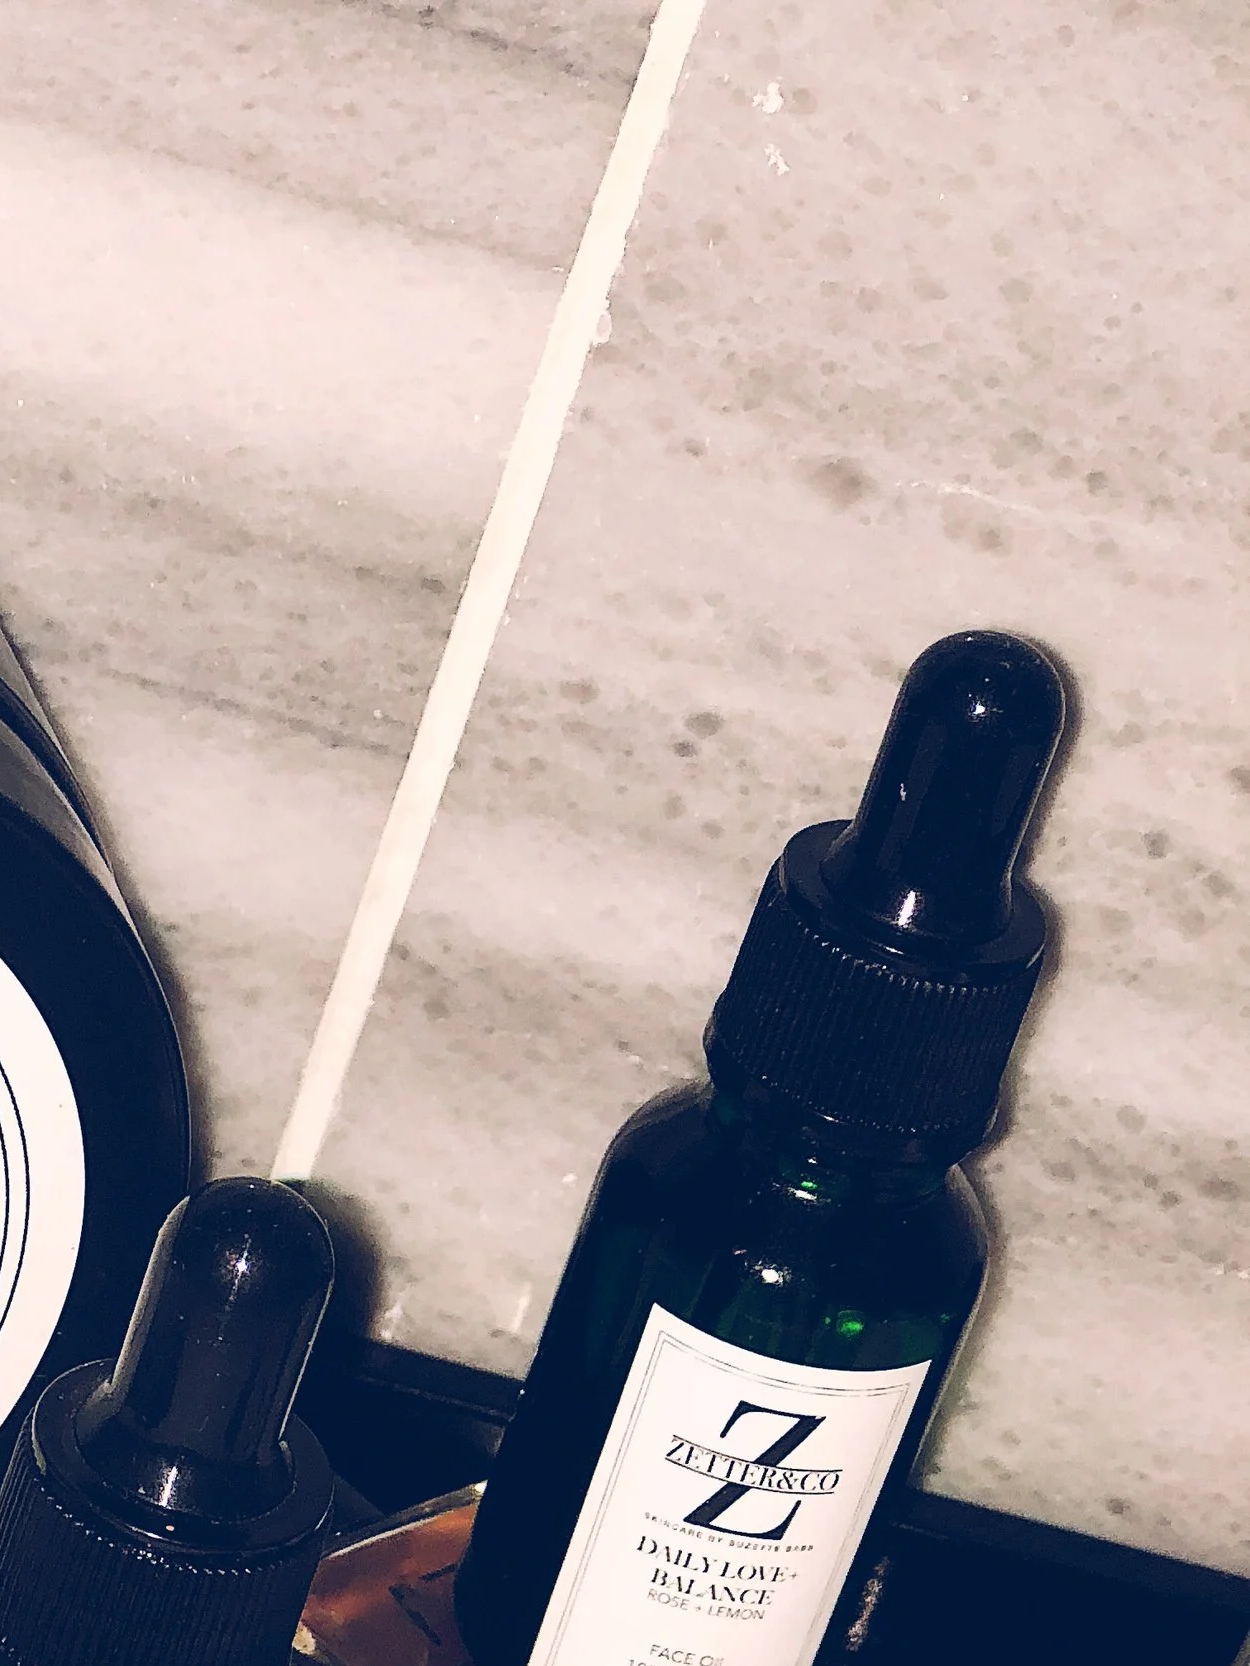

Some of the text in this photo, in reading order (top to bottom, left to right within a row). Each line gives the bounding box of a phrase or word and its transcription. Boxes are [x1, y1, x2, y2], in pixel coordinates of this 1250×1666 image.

[666, 1438, 840, 1492] ZETTER&CO
[637, 1536, 718, 1573] DAILY
[647, 1588, 689, 1611] ROSE
[708, 1605, 766, 1621] LEMON
[651, 1568, 775, 1605] BALANCE
[650, 1644, 696, 1665] FACE
